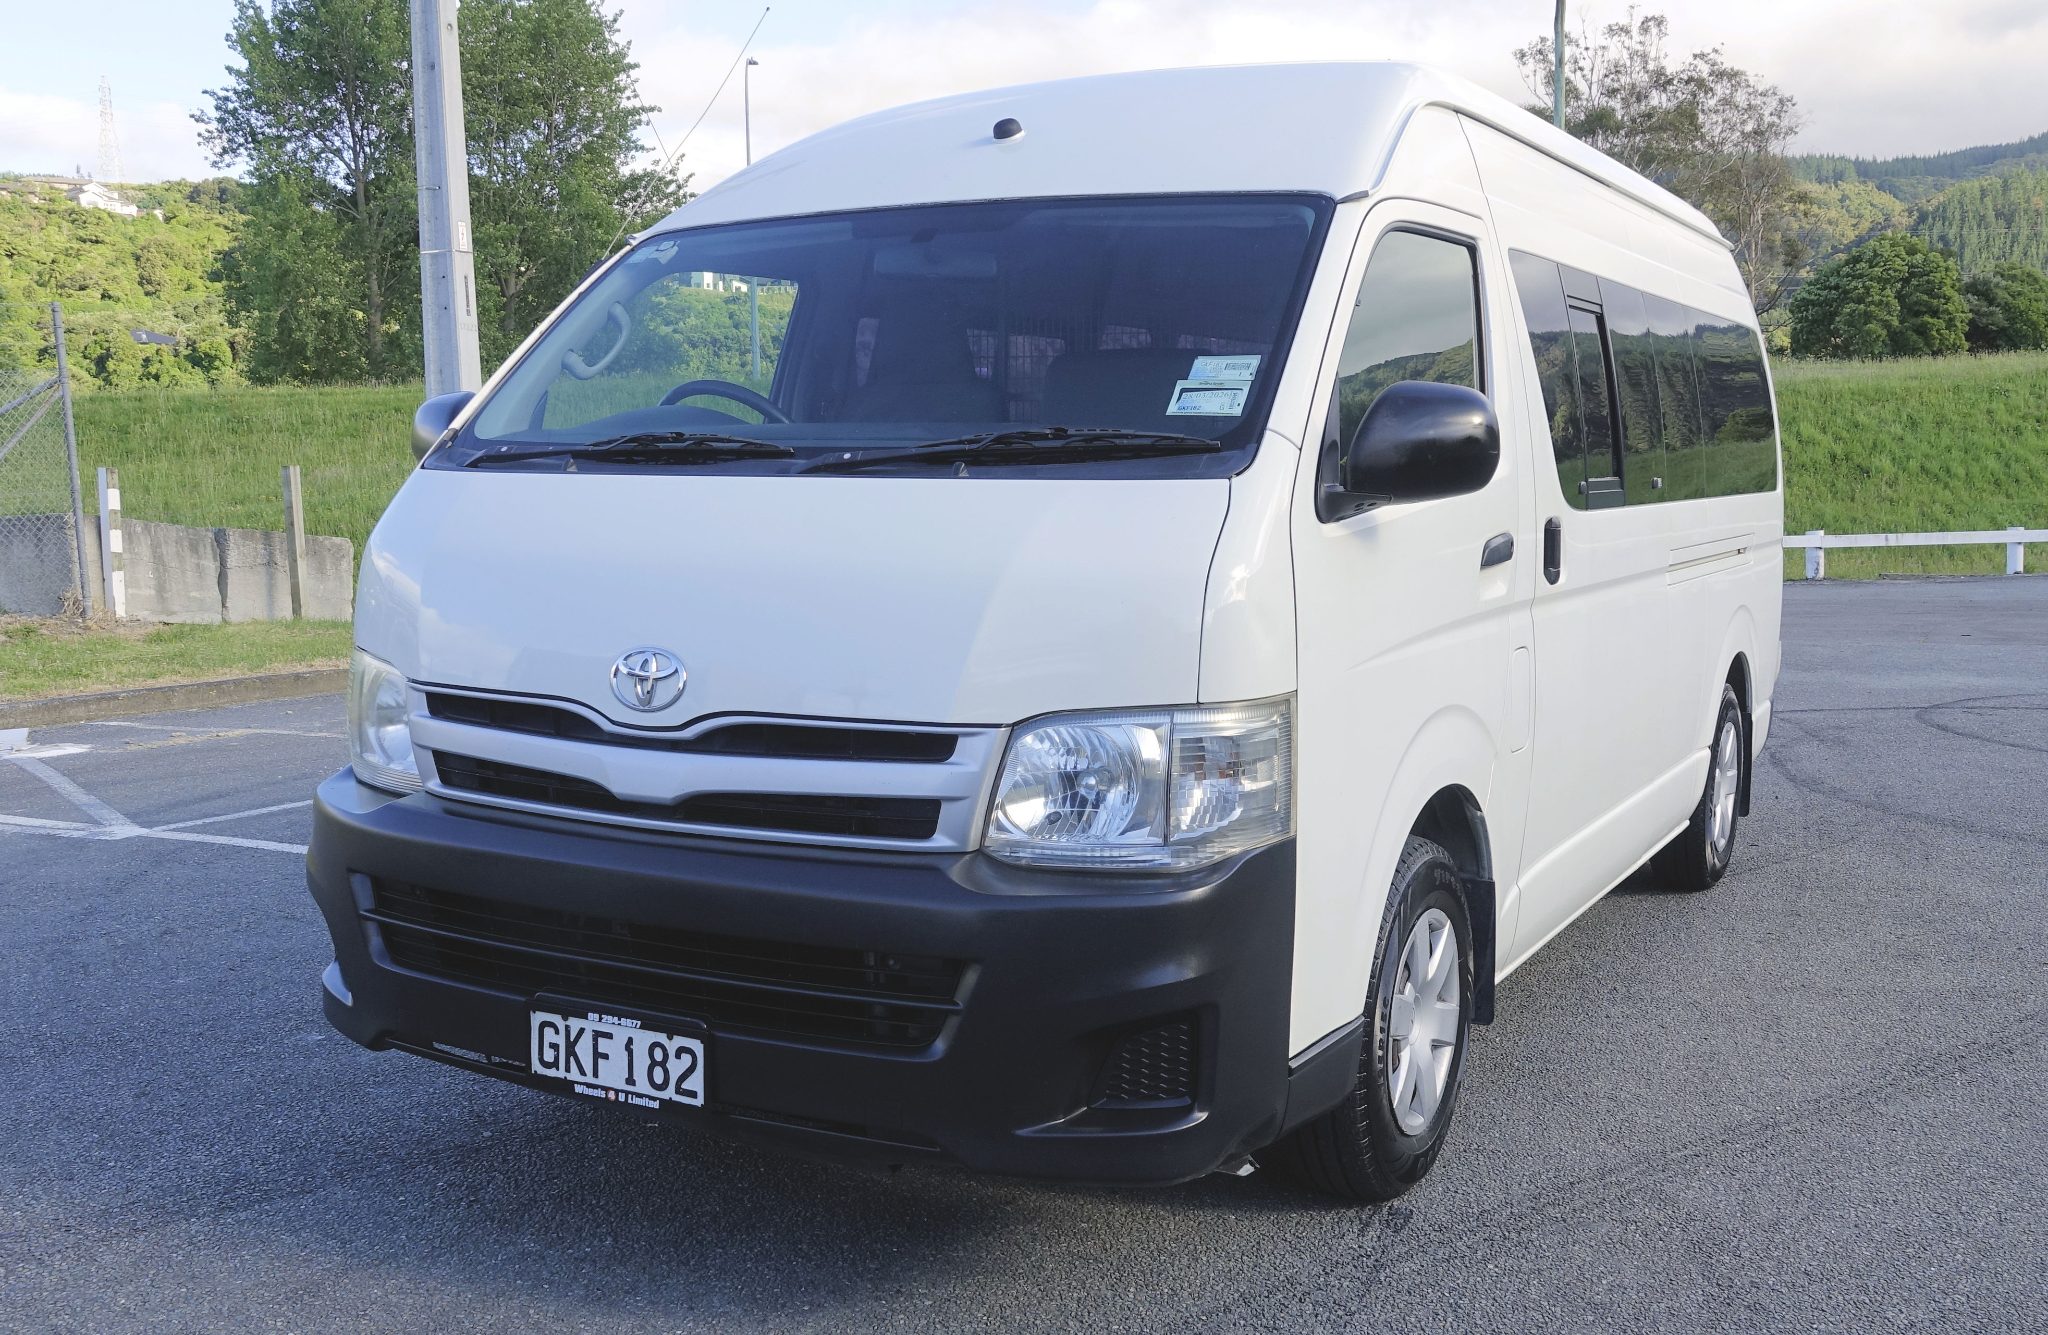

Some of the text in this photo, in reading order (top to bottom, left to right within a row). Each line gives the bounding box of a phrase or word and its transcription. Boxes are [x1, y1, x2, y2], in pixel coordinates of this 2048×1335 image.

[537, 1020, 698, 1100] GKF182
[574, 1083, 606, 1098] Wheels
[618, 1092, 626, 1102] U
[628, 1094, 660, 1109] Limited
